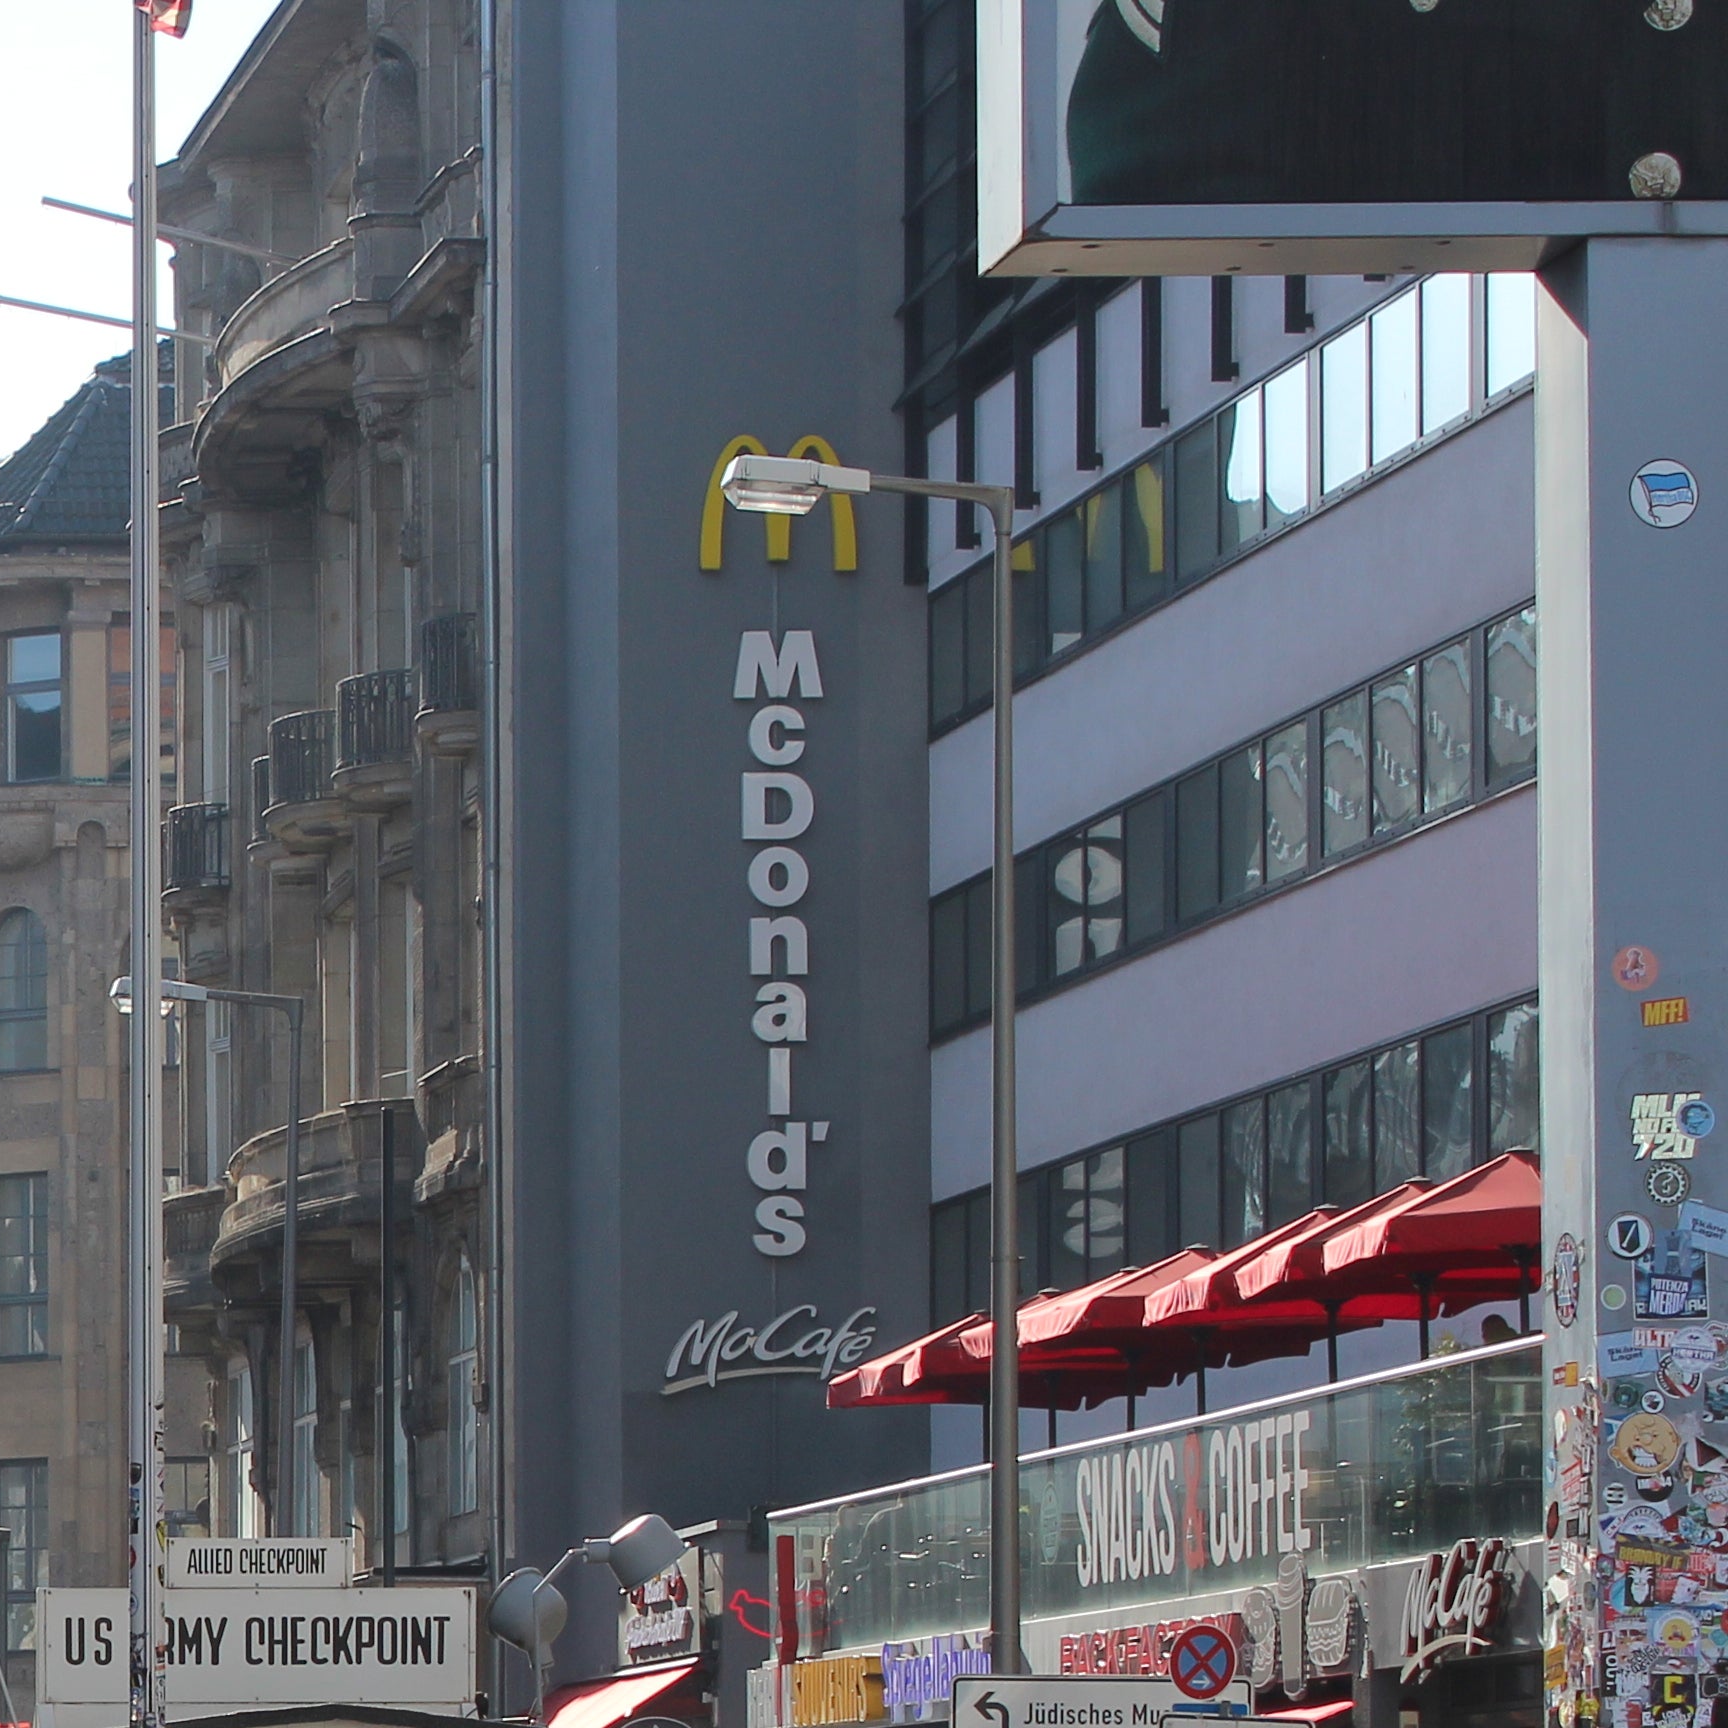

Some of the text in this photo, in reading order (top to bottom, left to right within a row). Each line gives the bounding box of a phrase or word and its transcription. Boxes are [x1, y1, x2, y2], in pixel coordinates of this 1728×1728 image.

[732, 630, 830, 1257] McDonald's
[1643, 999, 1684, 1027] MFF!
[1633, 1134, 1695, 1160] 720
[665, 1304, 878, 1388] McCafé
[1076, 1411, 1311, 1588] SNACKS & COFFEE
[187, 1547, 328, 1575] ALLIED CHECKPOINT
[64, 1615, 451, 1666] US RMY CHECKPOINT
[1023, 1702, 1124, 1725] Jüdisches
